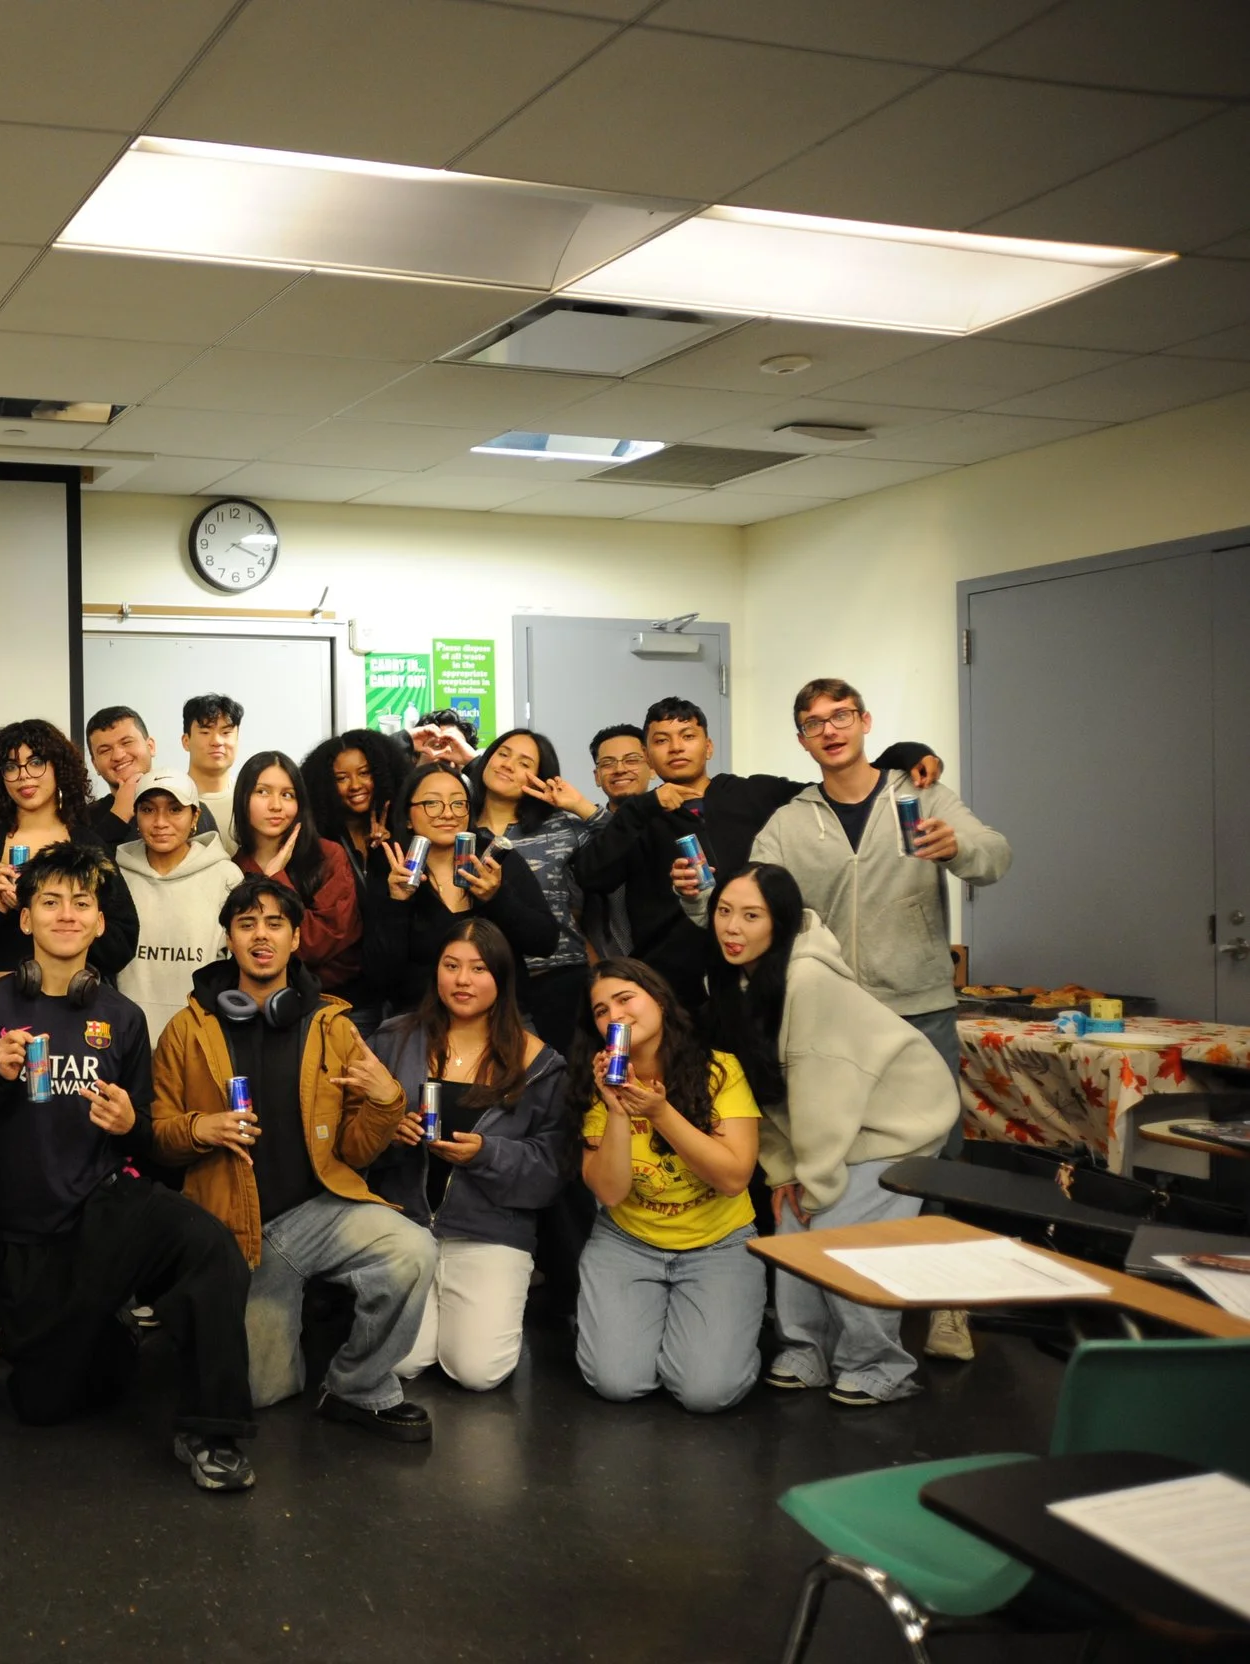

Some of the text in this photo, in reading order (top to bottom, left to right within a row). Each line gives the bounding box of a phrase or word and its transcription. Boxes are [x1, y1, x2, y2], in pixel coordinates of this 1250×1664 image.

[217, 511, 224, 522] 11
[230, 508, 240, 519] 12
[205, 523, 216, 535] 10
[256, 523, 264, 534] 2
[200, 539, 208, 549] 9
[205, 555, 213, 566] 8
[257, 556, 265, 567] 4
[218, 568, 225, 578] 7
[231, 572, 240, 582] 6
[247, 567, 255, 578] 5
[436, 641, 491, 653] Please dispose
[441, 652, 450, 661] of
[450, 652, 461, 660] all
[370, 659, 405, 672] CARRY
[452, 661, 475, 669] in the
[442, 670, 488, 679] appropriate
[370, 674, 427, 688] CARRY OUT
[438, 678, 481, 687] receptacles
[137, 945, 204, 962] ENTIALS
